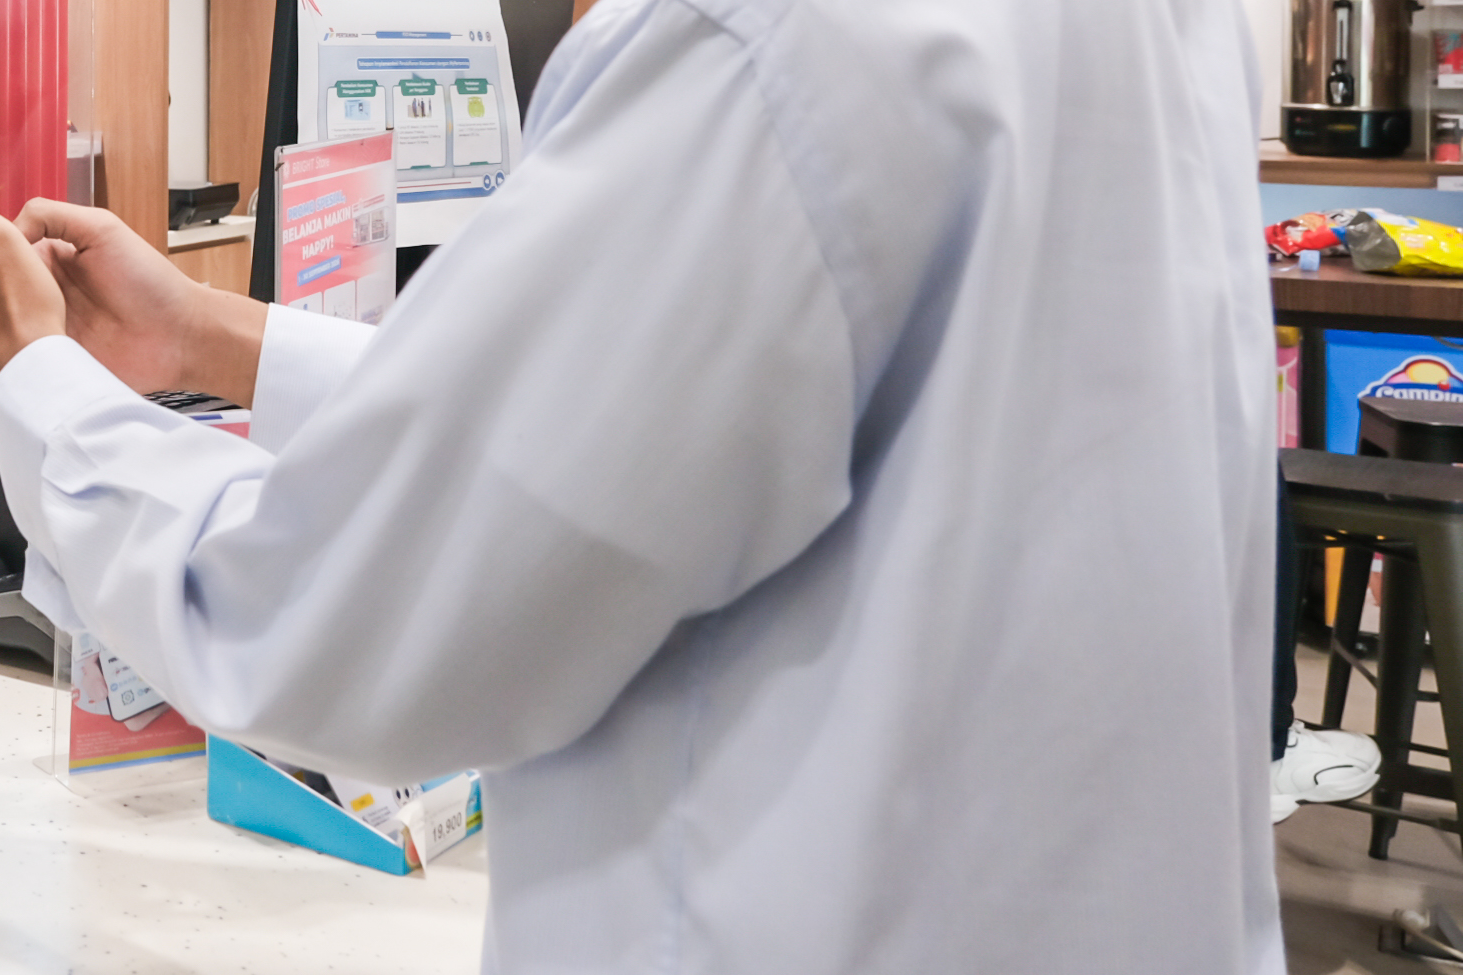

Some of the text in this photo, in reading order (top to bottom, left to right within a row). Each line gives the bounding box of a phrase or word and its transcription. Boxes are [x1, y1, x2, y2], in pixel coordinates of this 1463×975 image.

[292, 158, 314, 174] BRIGHT
[283, 206, 353, 245] BELANJA MAKIN
[302, 235, 334, 260] HAPPY!
[433, 811, 462, 843] 19,900
